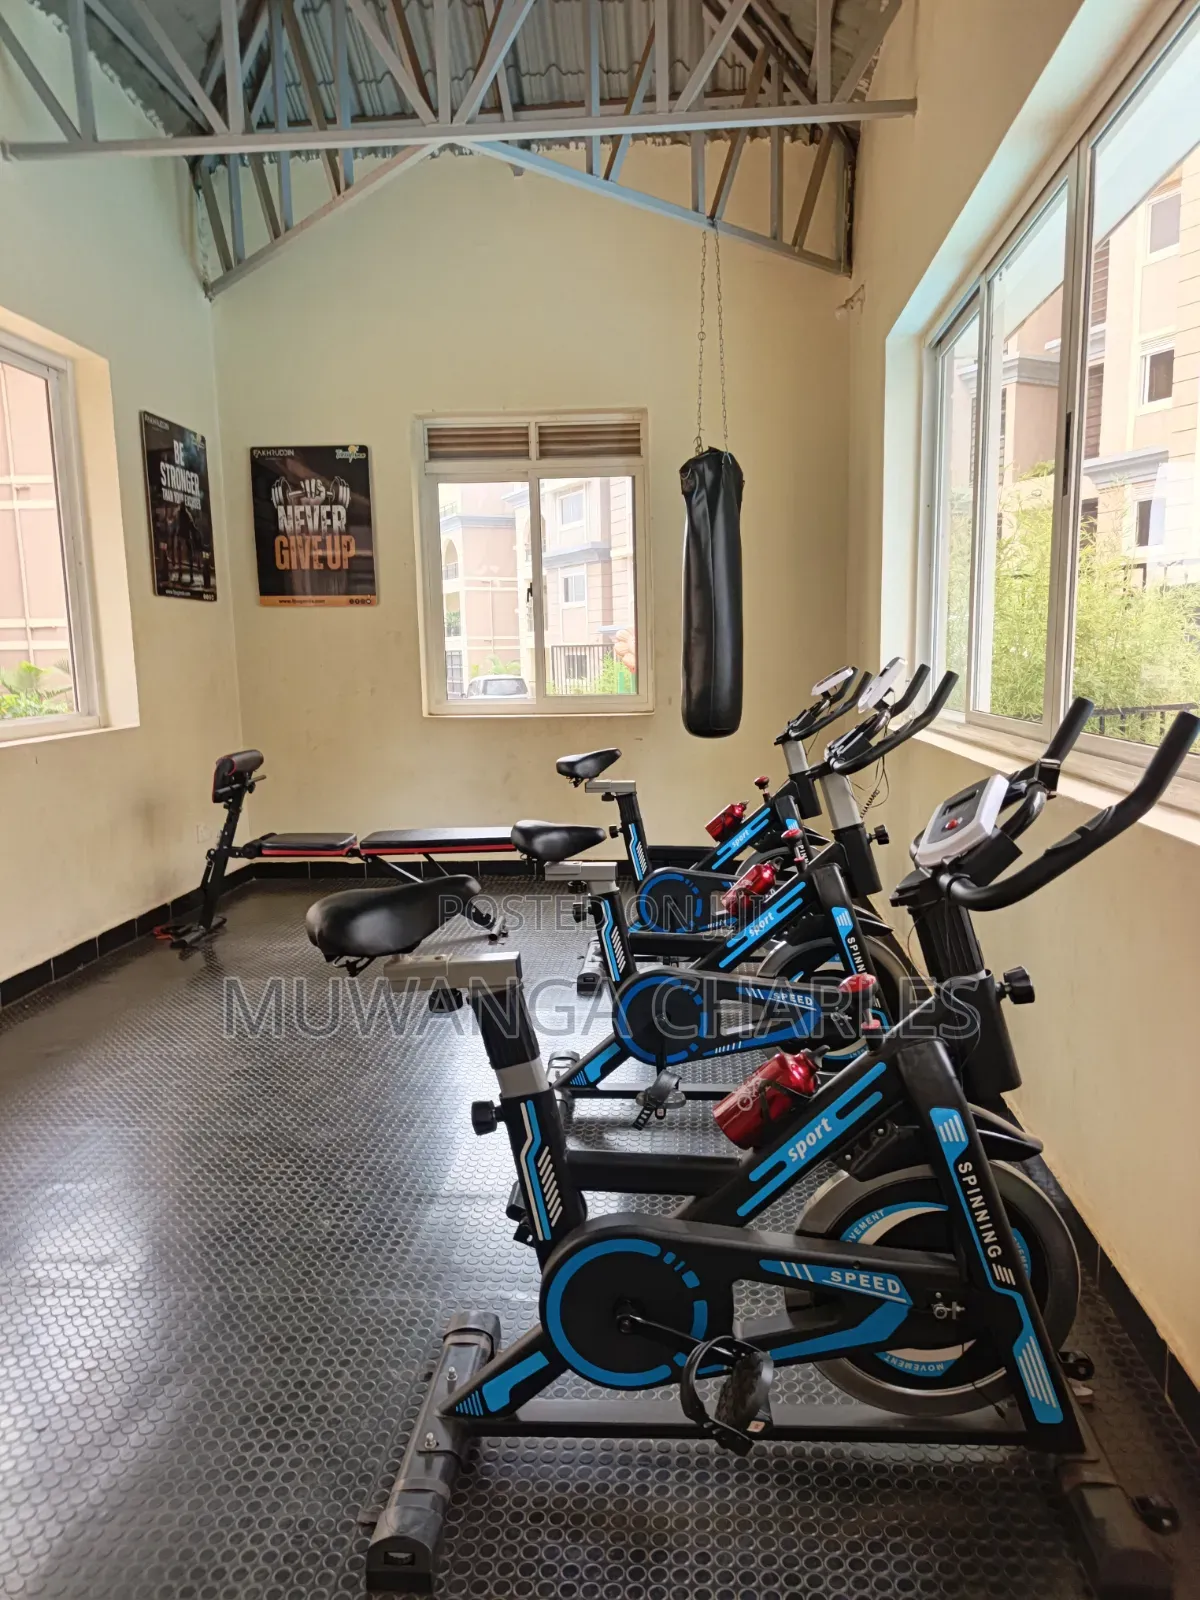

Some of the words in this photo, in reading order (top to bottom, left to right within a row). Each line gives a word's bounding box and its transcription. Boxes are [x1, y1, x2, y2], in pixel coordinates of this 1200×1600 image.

[173, 439, 185, 467] BE
[160, 461, 200, 497] STRONGER
[276, 504, 347, 533] NEVER
[274, 535, 325, 571] GIVE
[326, 534, 356, 570] UP
[731, 829, 750, 848] sport
[749, 912, 775, 937] sport
[846, 936, 868, 975] SPINN
[772, 991, 814, 1007] SPEED
[787, 1116, 834, 1163] sport
[957, 1160, 1003, 1259] SPINNING
[846, 1208, 885, 1243] VEMENT
[830, 1270, 901, 1295] SPEED
[883, 1354, 945, 1372] MOVEMENT
